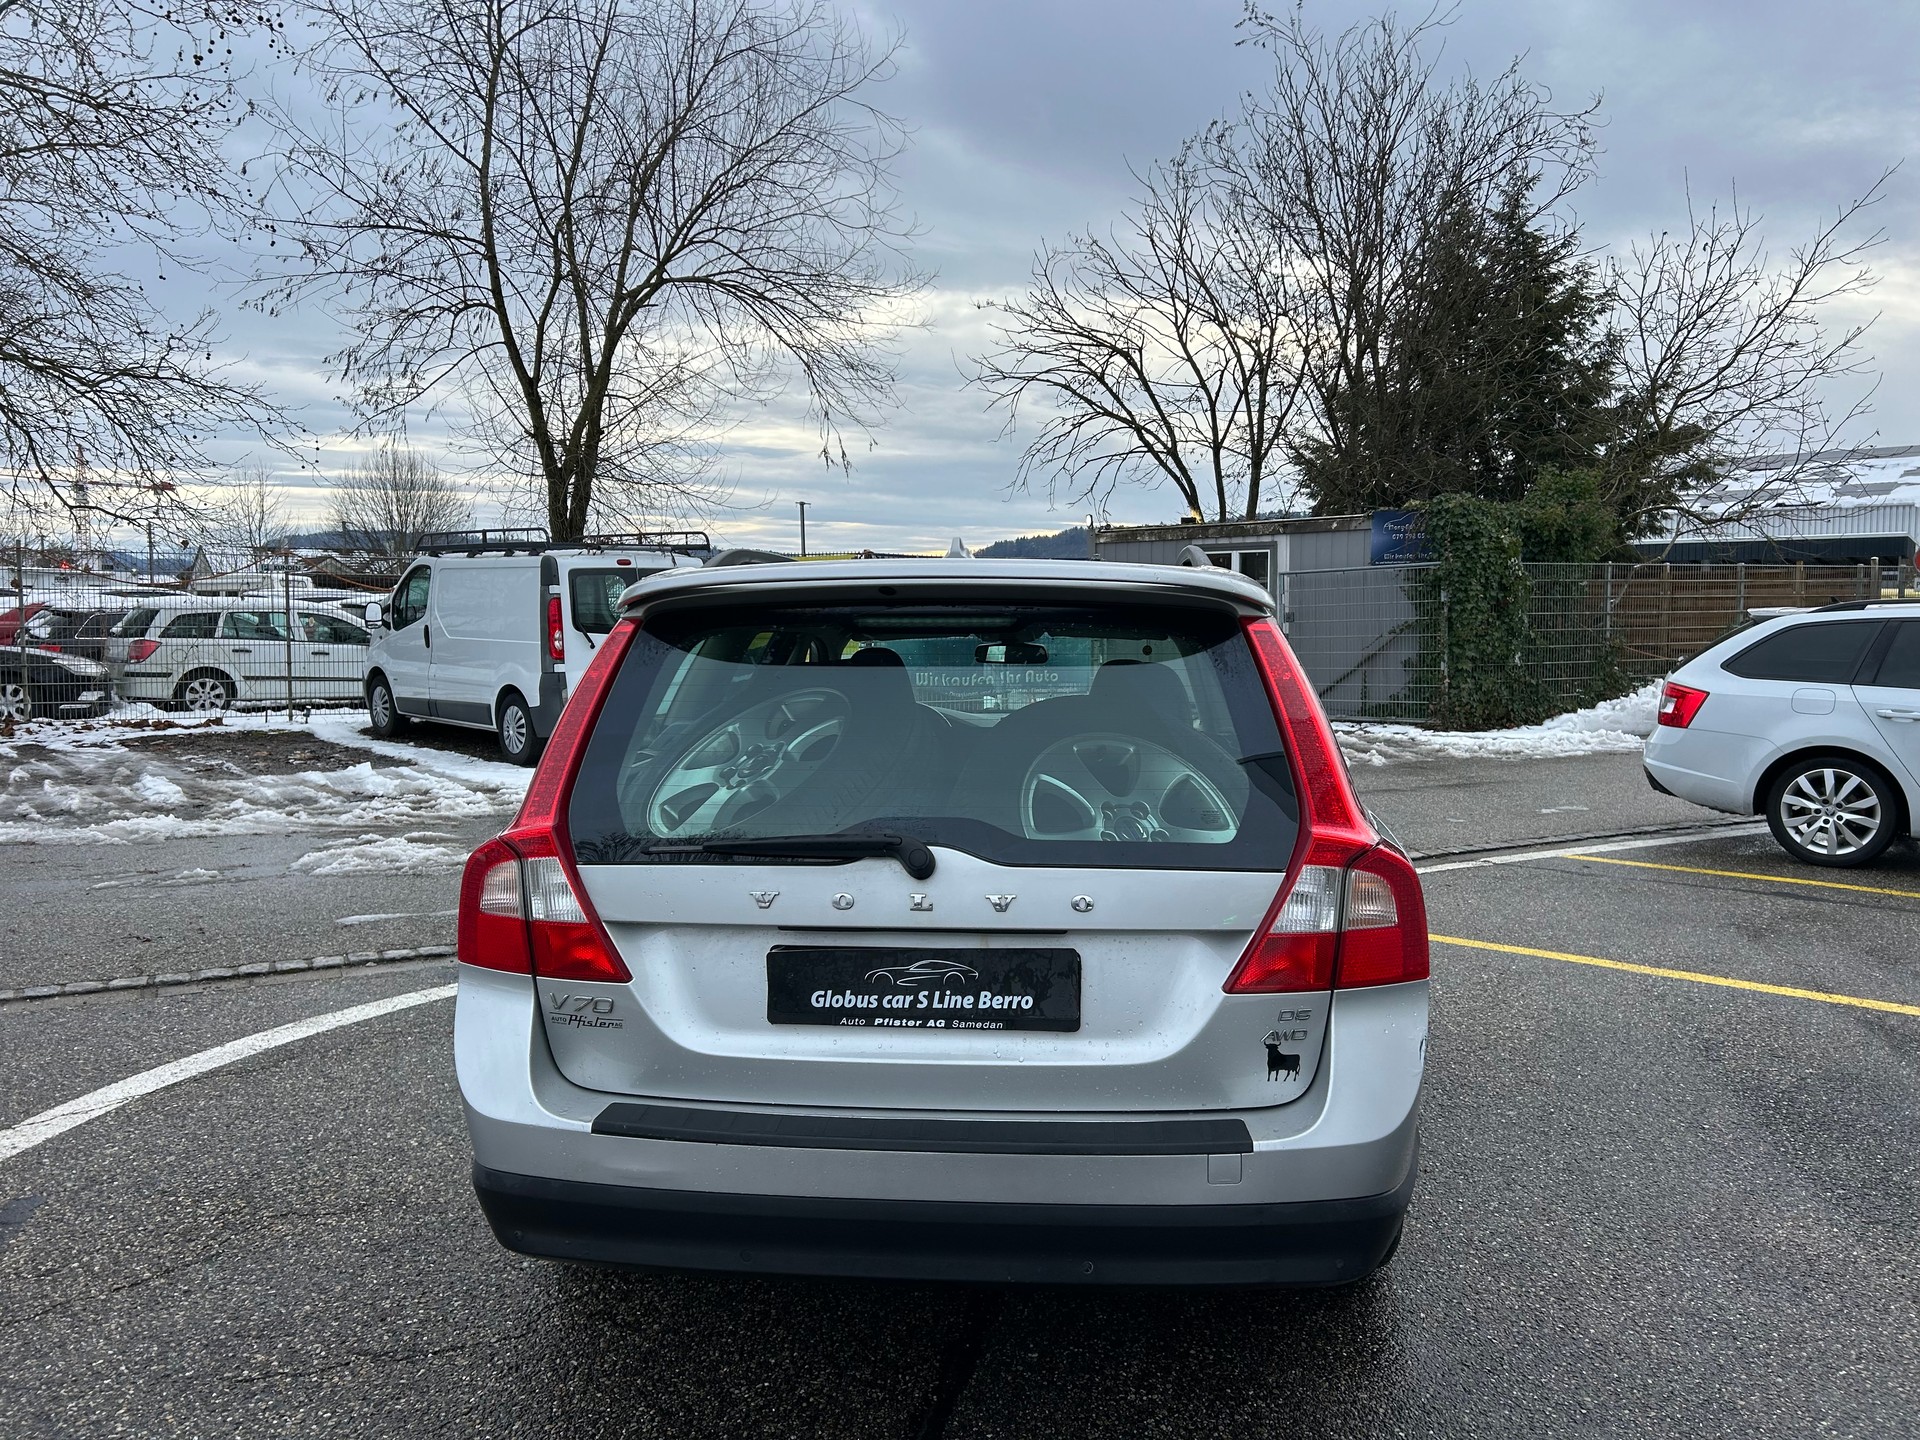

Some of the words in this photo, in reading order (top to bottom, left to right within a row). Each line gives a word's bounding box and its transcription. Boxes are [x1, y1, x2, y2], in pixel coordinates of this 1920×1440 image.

[915, 672, 939, 687] Wir
[941, 672, 995, 687] kaufen
[1000, 670, 1021, 684] Ihr
[1025, 669, 1059, 683] Auto
[750, 891, 1095, 913] VOLVO
[549, 992, 614, 1013] V70
[811, 990, 879, 1009] Globus
[882, 994, 914, 1009] car
[916, 990, 929, 1009] S
[932, 990, 974, 1009] Line
[978, 990, 1034, 1010] Berro
[551, 1015, 567, 1023] AUTO
[568, 1014, 614, 1028] Pfister
[840, 1017, 866, 1026] Auto
[874, 1018, 922, 1027] Pfister
[926, 1019, 946, 1028] AG
[952, 1019, 1003, 1029] Samedan
[1260, 1028, 1308, 1042] AWD
